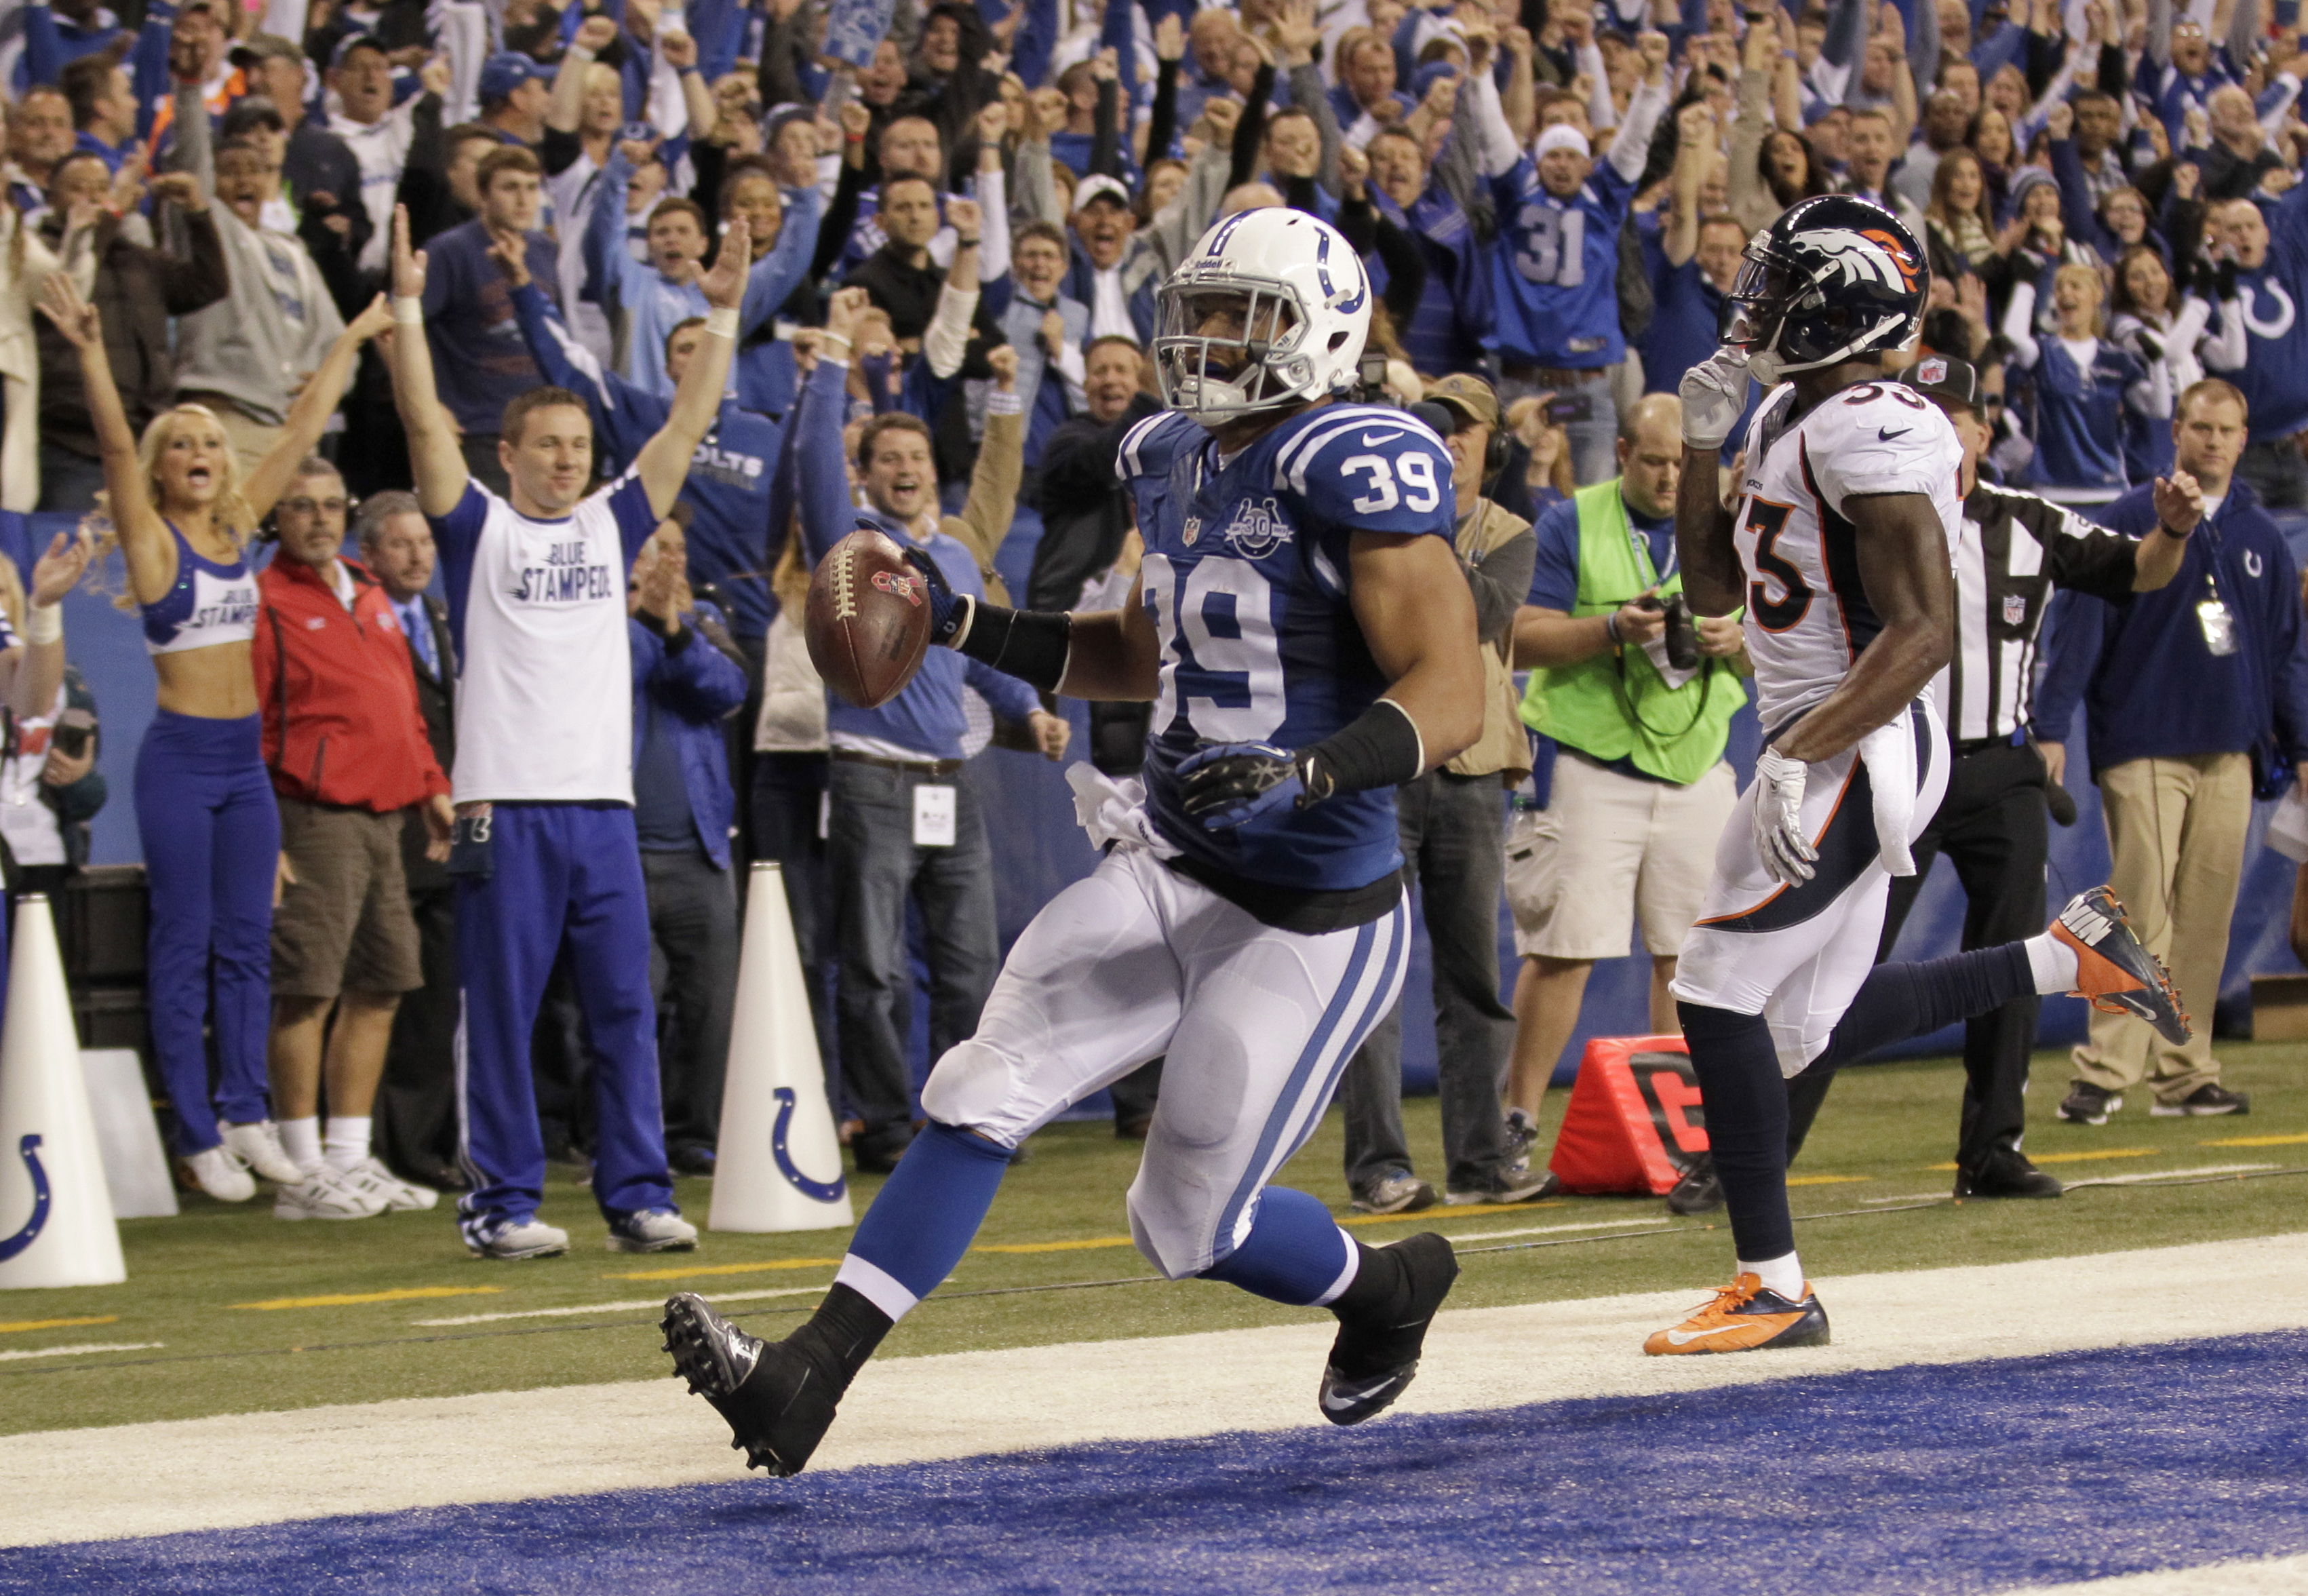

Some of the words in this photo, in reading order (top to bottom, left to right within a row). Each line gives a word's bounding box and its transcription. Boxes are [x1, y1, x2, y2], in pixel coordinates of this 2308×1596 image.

[1516, 204, 1586, 287] 31
[691, 444, 764, 478] OLTS
[1339, 450, 1440, 514] 39
[547, 541, 585, 566] BLUE
[1738, 493, 1815, 634] 3
